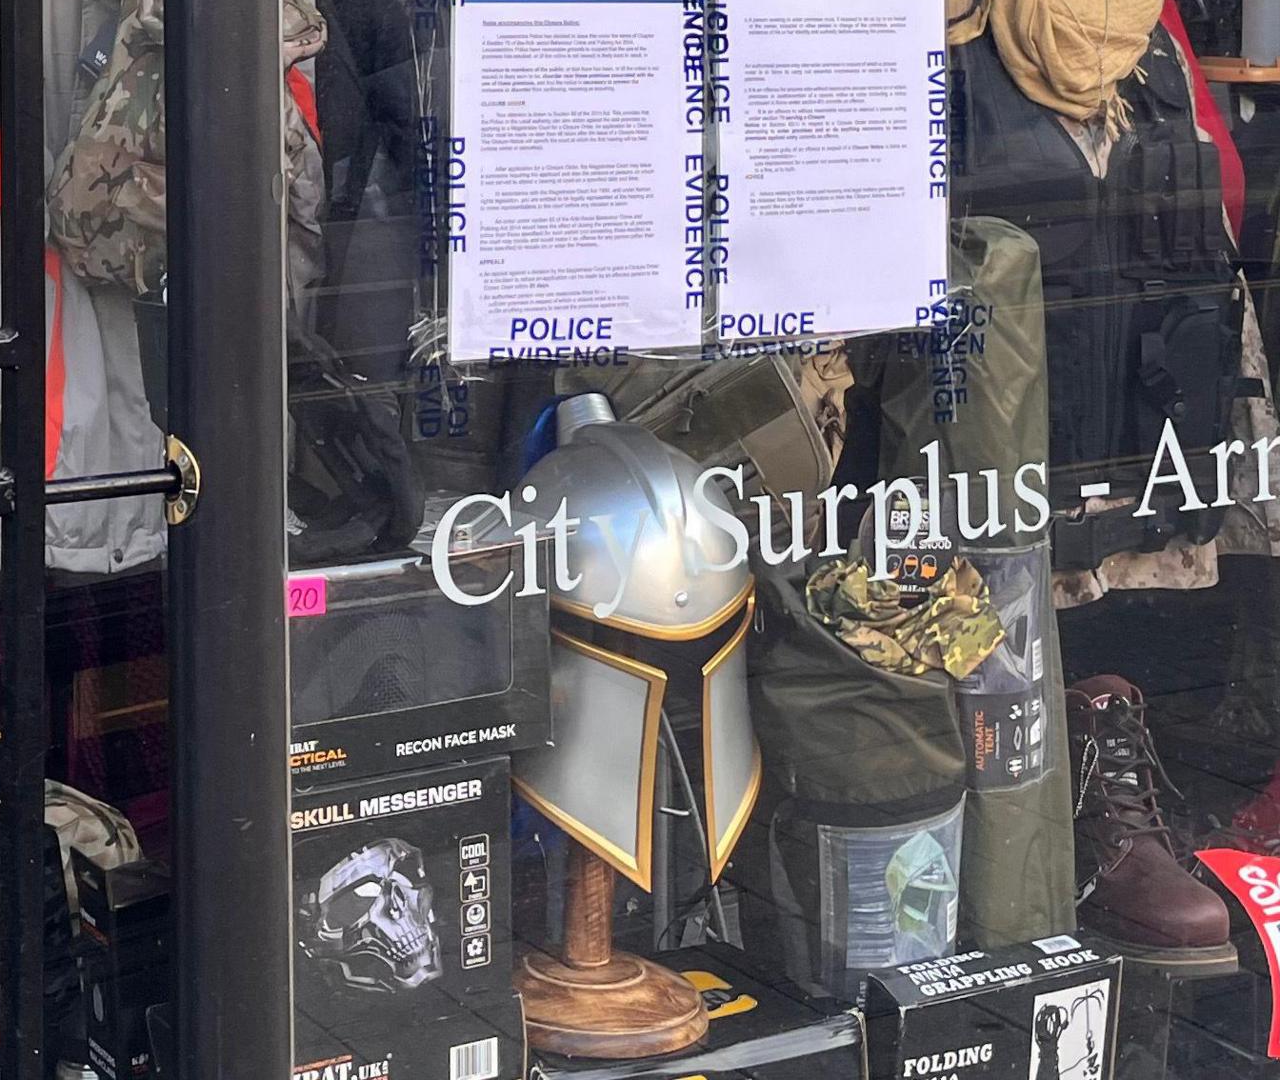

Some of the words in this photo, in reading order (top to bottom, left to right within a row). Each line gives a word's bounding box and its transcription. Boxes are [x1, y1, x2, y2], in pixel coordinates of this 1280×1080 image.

[927, 51, 948, 199] EVIDENCE
[446, 136, 467, 253] POLICE
[685, 155, 705, 309] EVIDENCE
[709, 174, 729, 284] POLICE
[510, 317, 613, 341] POLICE
[721, 312, 815, 337] POLICE
[431, 485, 654, 618] City
[692, 440, 1050, 582] Surplus
[1081, 482, 1111, 498] -
[395, 736, 443, 757] RECON
[444, 731, 478, 749] FACE
[478, 723, 517, 744] MASK
[975, 709, 985, 771] AUTOMATIC
[985, 726, 995, 754] TENT
[290, 803, 354, 831] SKULL
[359, 779, 483, 817] MESSENGER
[461, 841, 488, 860] COOL
[897, 951, 985, 975] FOLDING
[908, 963, 967, 987] NINJA
[919, 963, 1033, 997] GRAPPLING
[1037, 949, 1101, 972] HOOK
[903, 1043, 993, 1078] FOLDING
